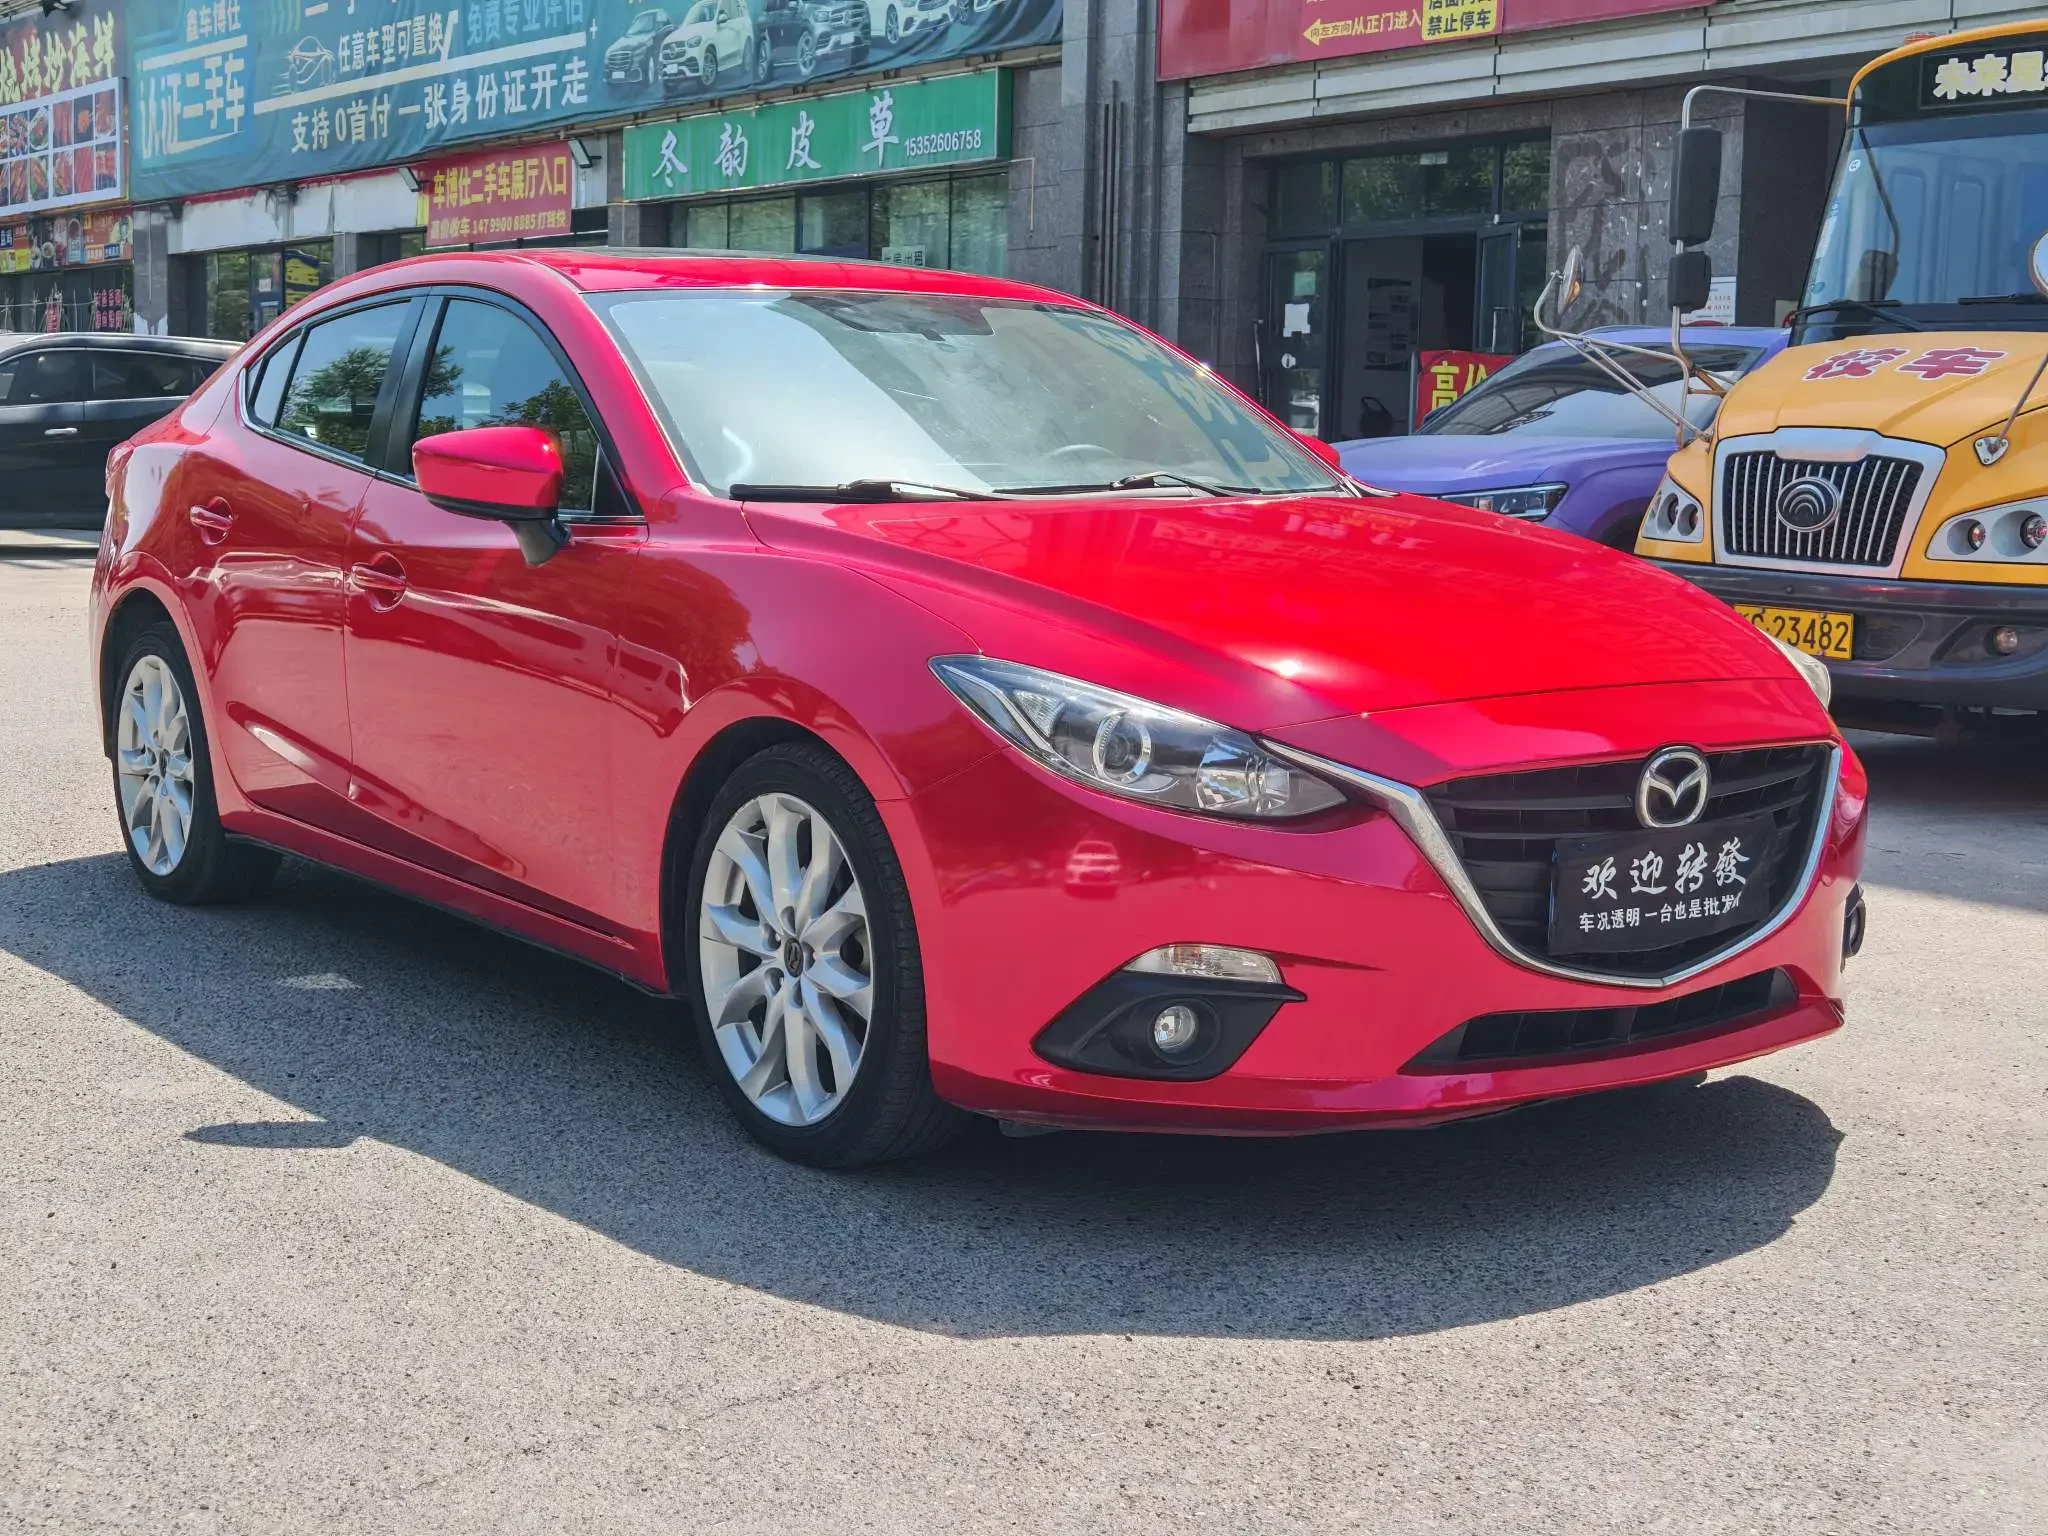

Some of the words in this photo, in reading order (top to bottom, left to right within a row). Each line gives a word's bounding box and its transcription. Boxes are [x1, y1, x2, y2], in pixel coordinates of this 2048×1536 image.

[339, 11, 445, 73] 任意车型可置换
[466, 0, 584, 47] 免费专业评估
[1351, 9, 1422, 36] 从正门进入
[1427, 9, 1491, 36] 禁止停车
[1933, 50, 2048, 100] 未来星
[139, 52, 245, 160] 认证二手车
[652, 90, 899, 188] 冬韵皮草
[904, 129, 982, 157] 15352606758
[433, 156, 568, 209] 车博仕二手车展厅入口
[1803, 347, 2008, 381] 校车
